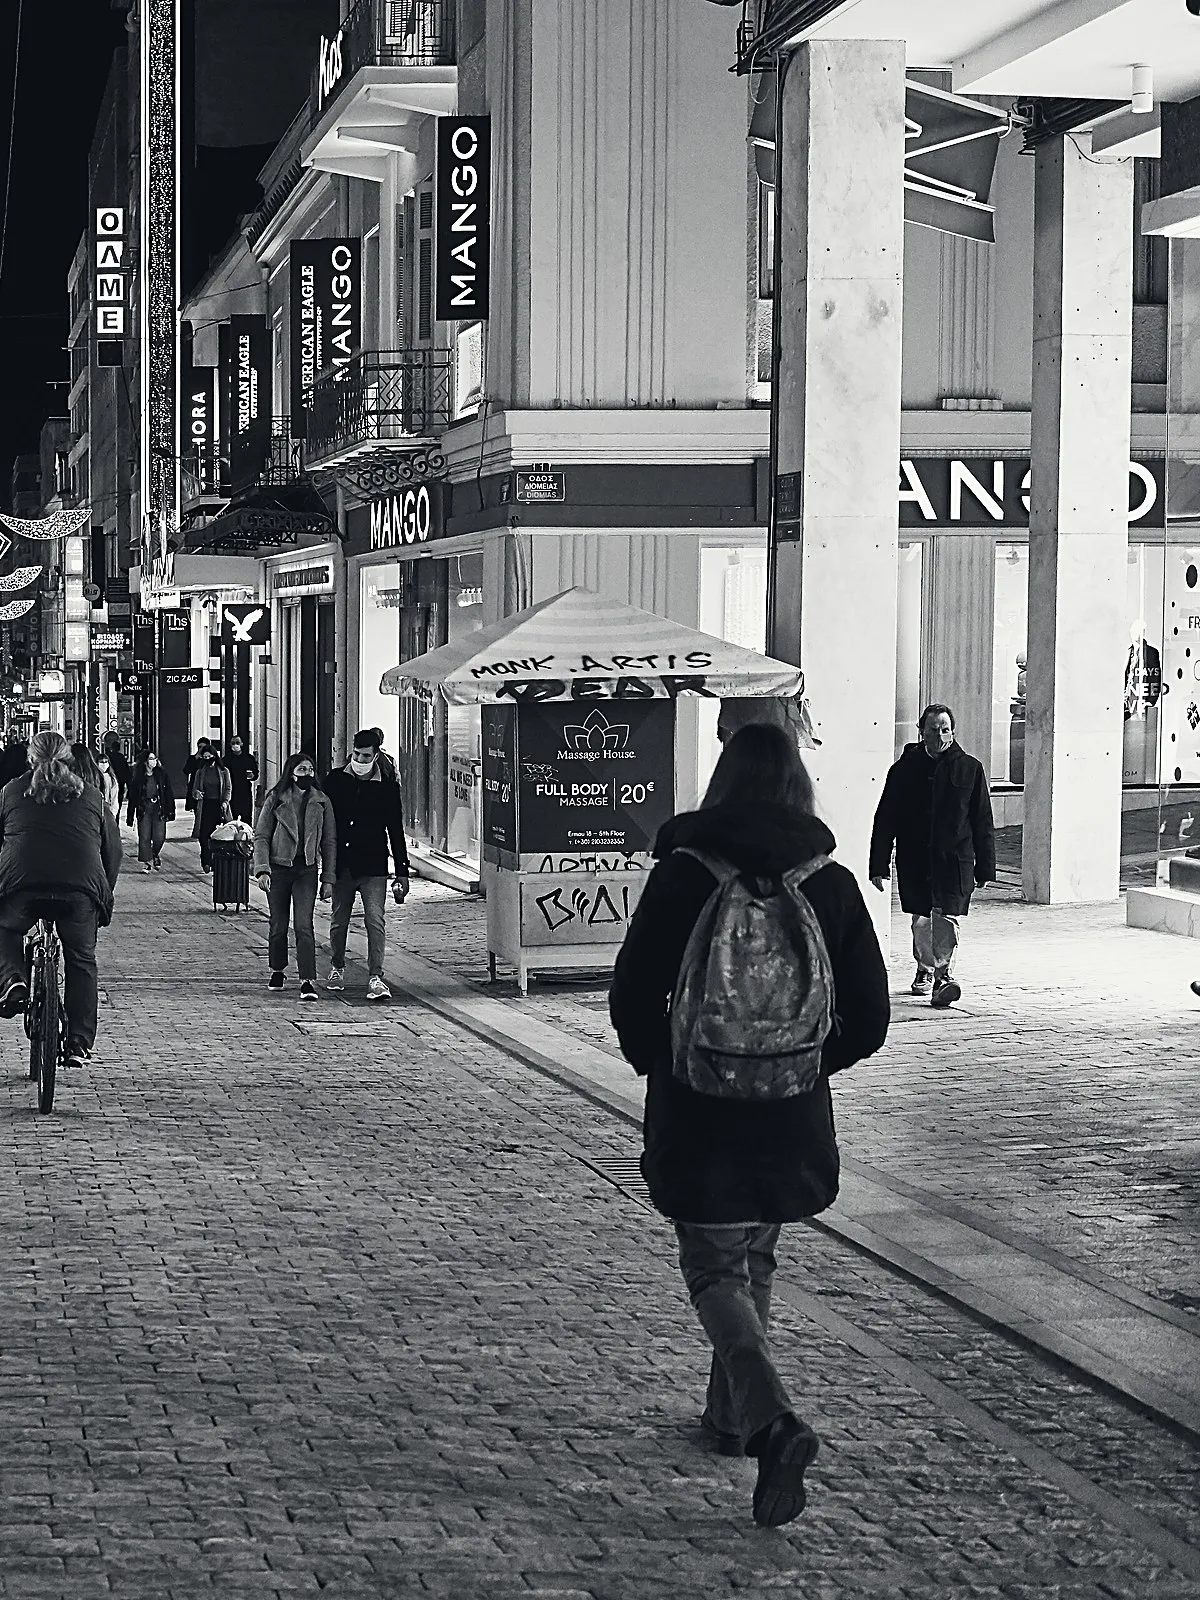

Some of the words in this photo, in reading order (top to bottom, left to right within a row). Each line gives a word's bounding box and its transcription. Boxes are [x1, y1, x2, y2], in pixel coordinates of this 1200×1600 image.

[450, 126, 478, 306] MANGO
[302, 265, 314, 319] EAGLE
[331, 245, 351, 382] MANGO
[238, 335, 250, 378] EAGLE
[238, 381, 250, 436] ERICAN
[524, 482, 558, 490] ΔΙΟΜΕΙΑΣ
[370, 485, 430, 549] MANGO
[135, 614, 154, 625] Ths
[165, 613, 188, 627] Ths
[135, 659, 154, 671] Ths
[166, 674, 180, 683] ZIC
[181, 674, 198, 683] ZAC
[557, 750, 600, 762] Massage
[536, 784, 568, 796] FULL
[571, 784, 609, 796] BODY
[559, 797, 609, 806] MASSAGE
